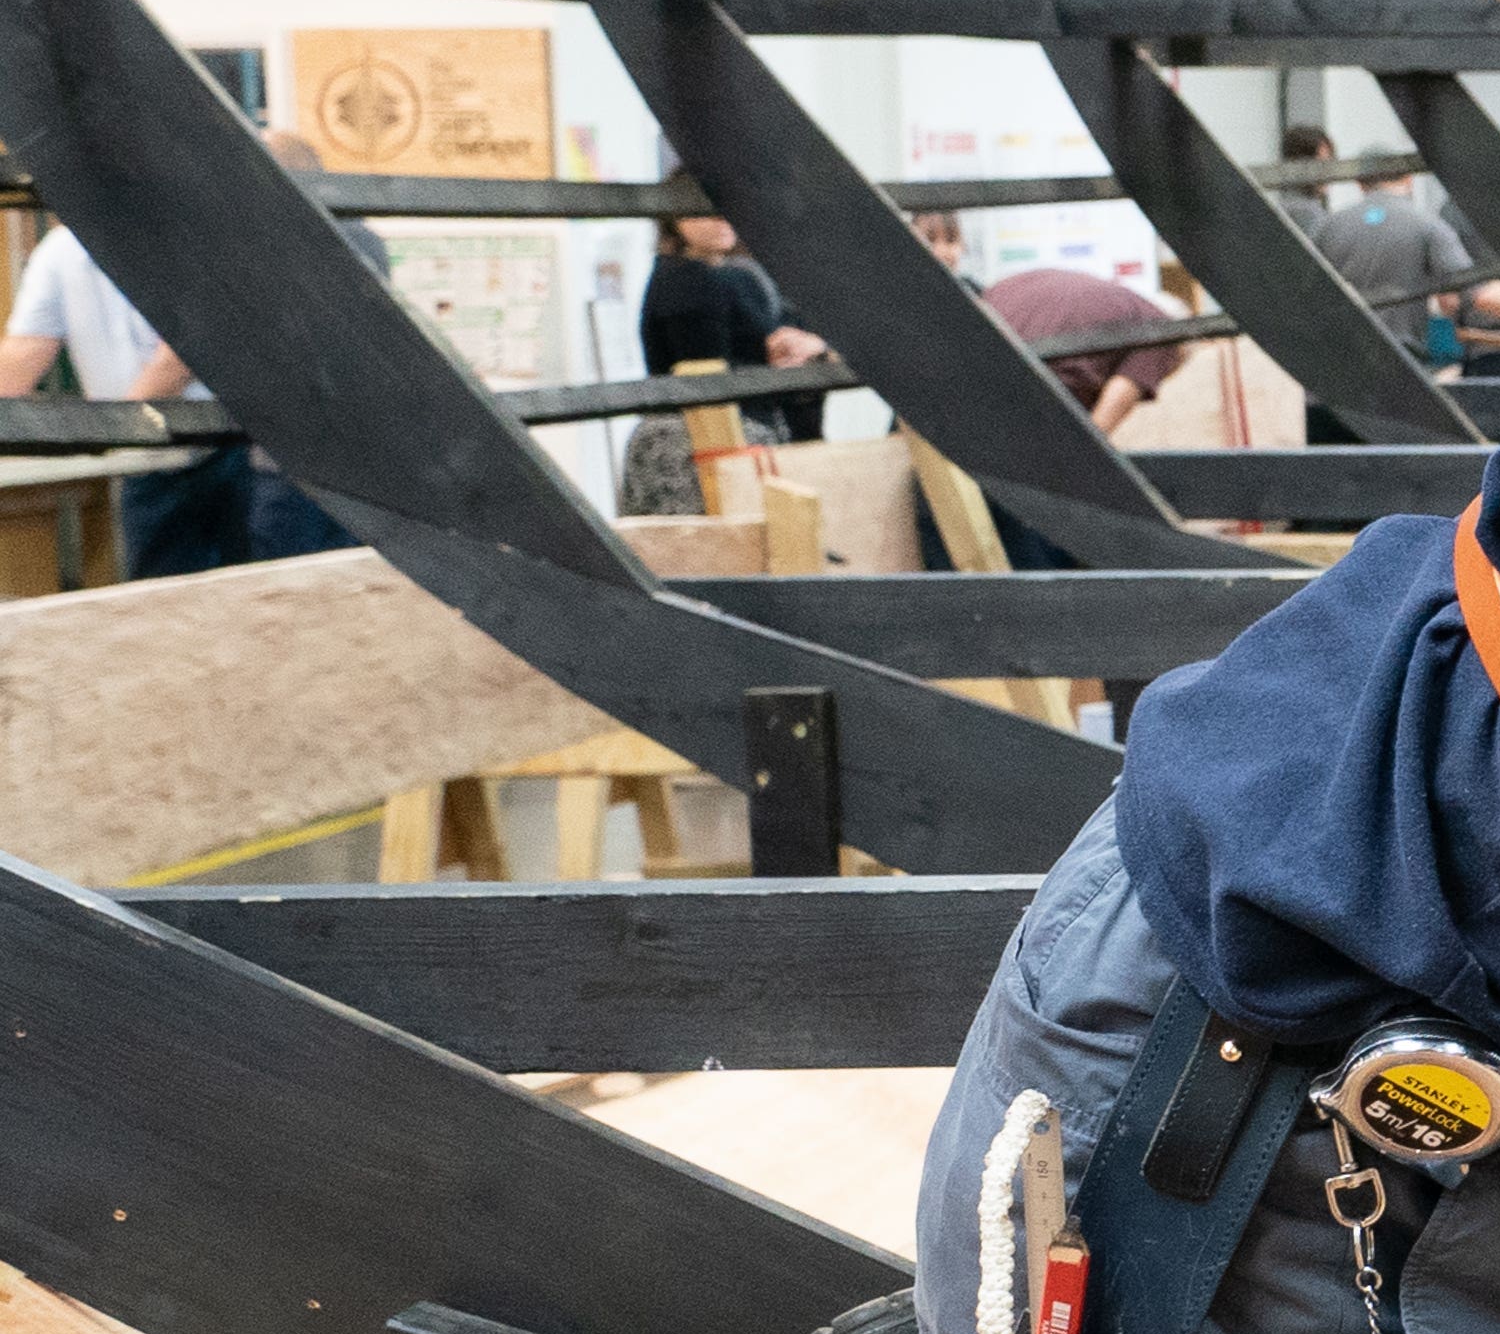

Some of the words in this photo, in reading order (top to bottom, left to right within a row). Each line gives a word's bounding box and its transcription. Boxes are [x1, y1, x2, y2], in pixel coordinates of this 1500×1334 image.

[1376, 1081, 1463, 1134] PowerLock
[1402, 1075, 1471, 1116] STANLEY
[1364, 1099, 1453, 1148] 5m/16'
[1036, 1160, 1049, 1179] 150
